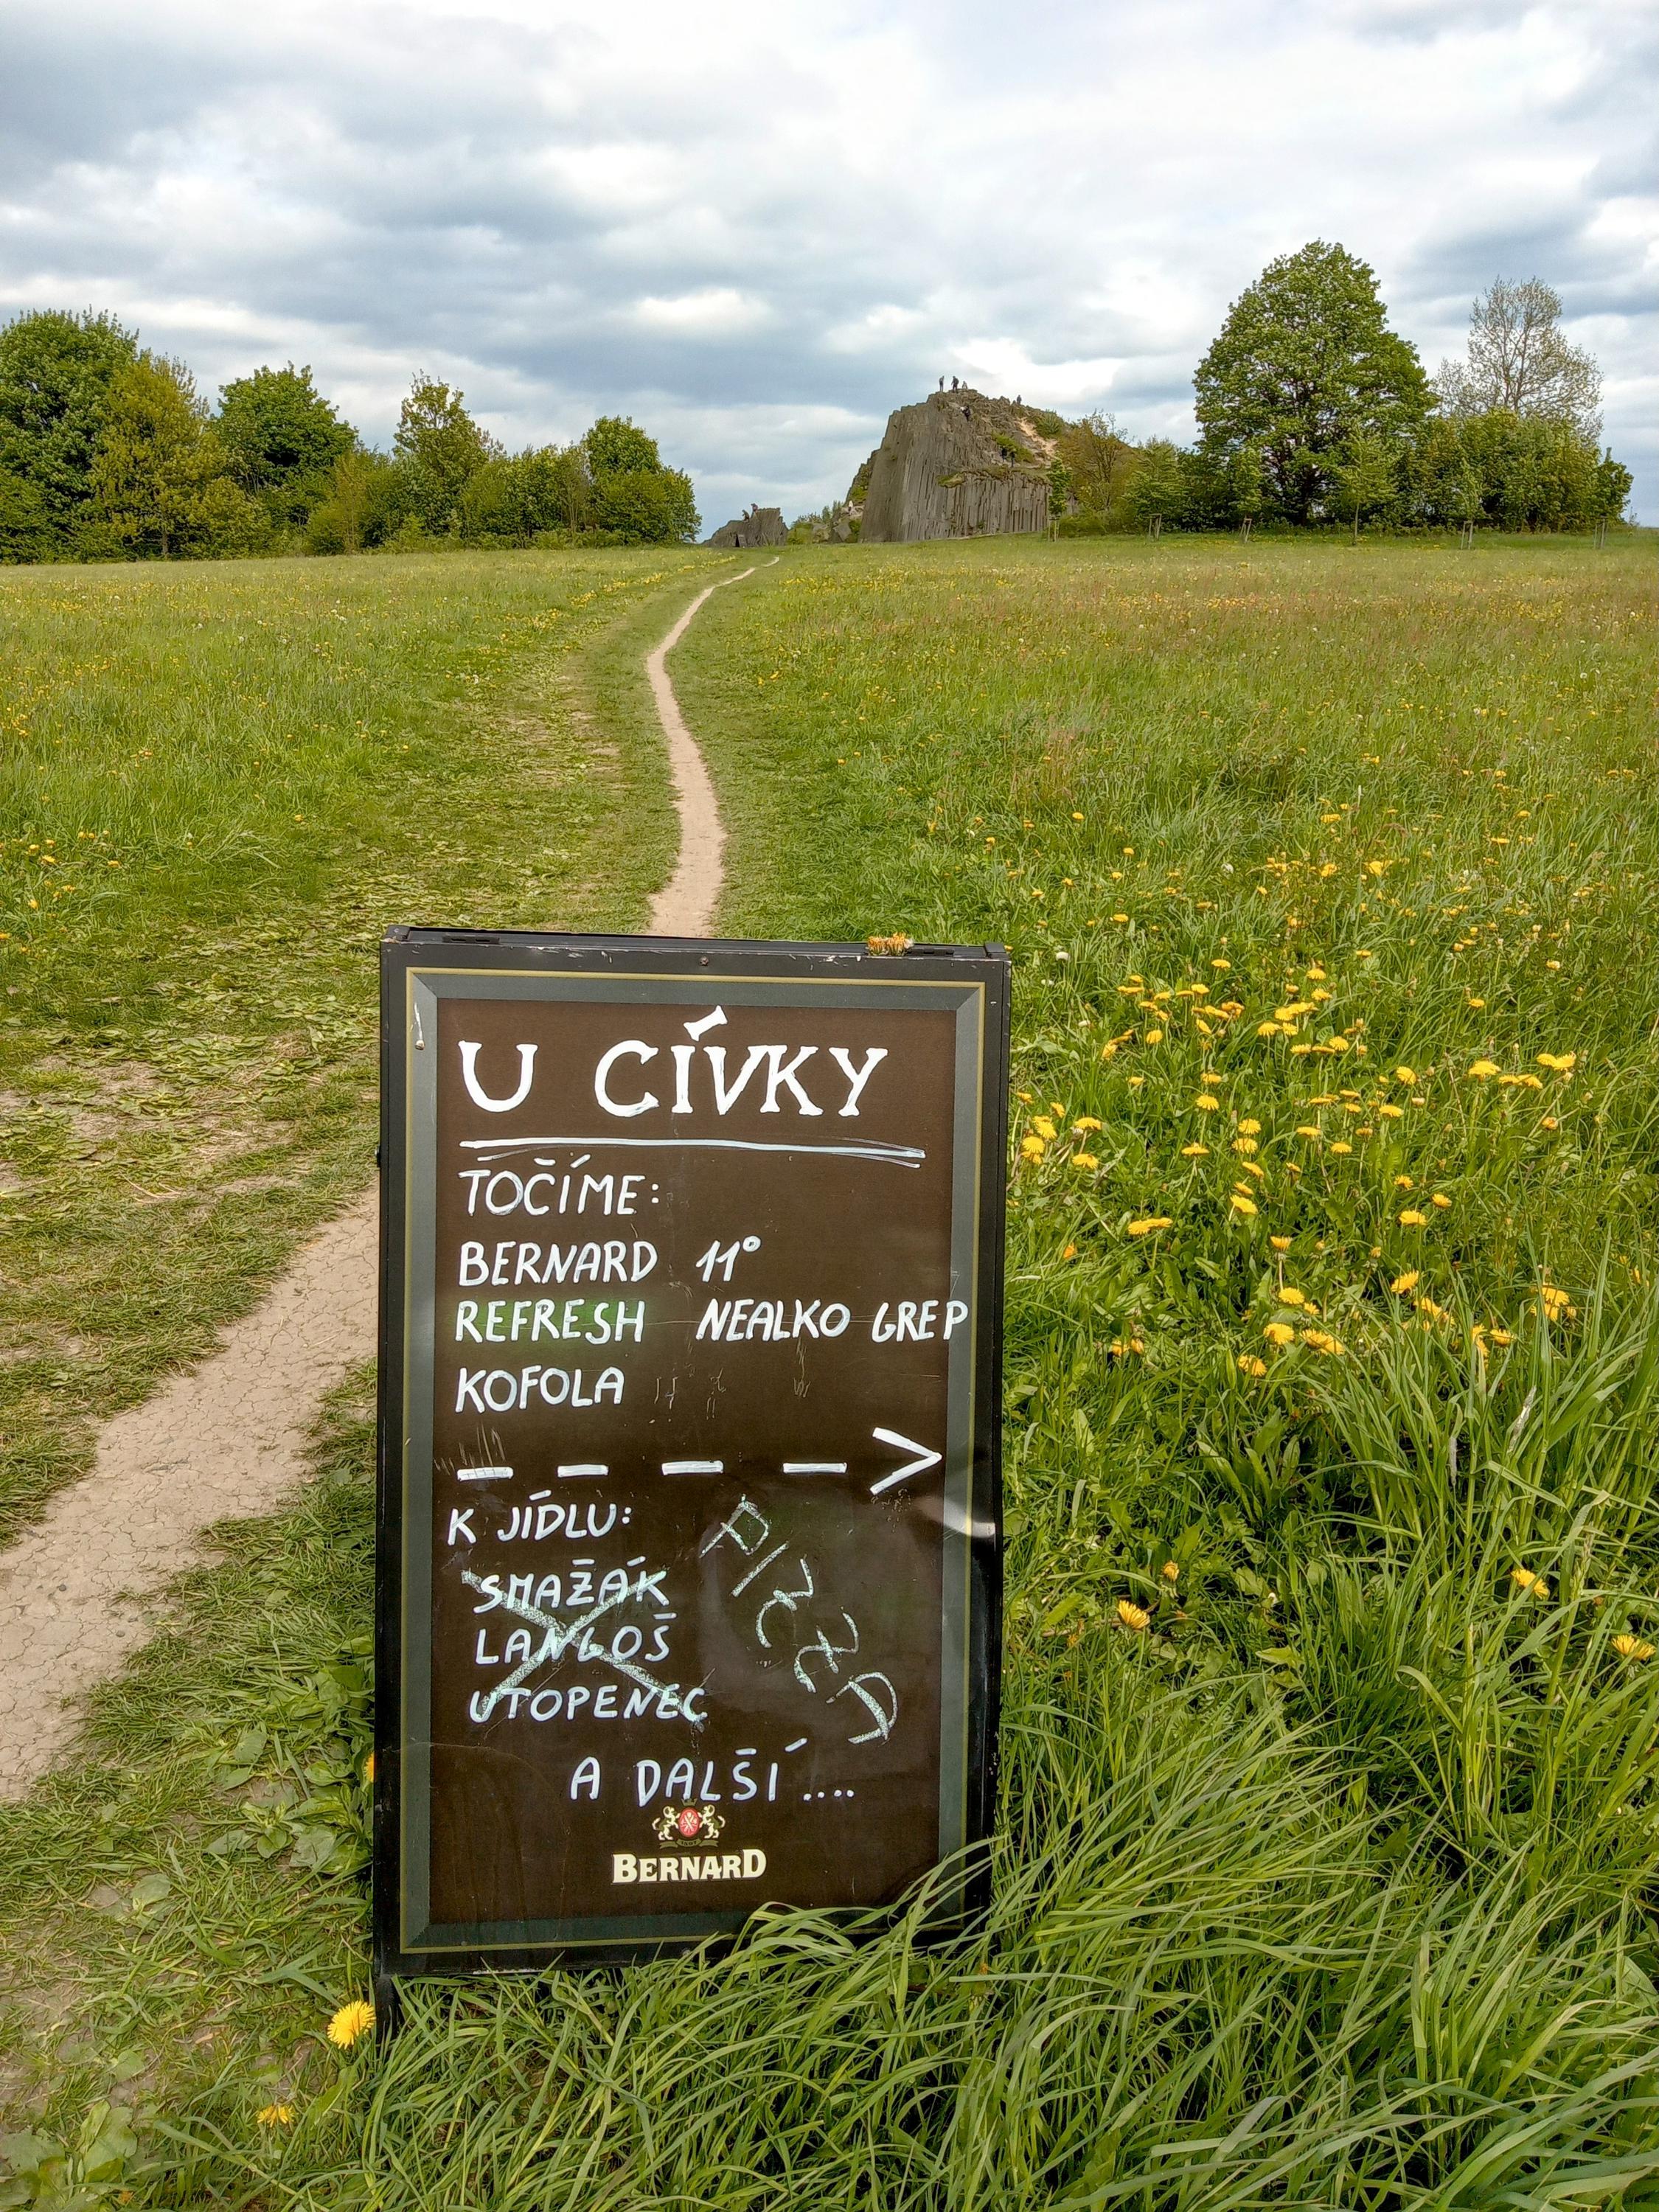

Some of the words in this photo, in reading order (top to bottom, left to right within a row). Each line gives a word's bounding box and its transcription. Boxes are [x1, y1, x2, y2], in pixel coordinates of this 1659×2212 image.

[458, 1040, 538, 1113] U
[594, 1005, 888, 1117] CÍVKY
[458, 1153, 659, 1216] TOČÍME:
[459, 1240, 658, 1287] BERNARD
[695, 1235, 761, 1283] 11°
[455, 1298, 645, 1345] REFRESH
[695, 1298, 851, 1342] NEALKO
[872, 1300, 969, 1343] GREP
[455, 1364, 625, 1413] KOFOLA
[448, 1508, 476, 1545] K
[497, 1489, 632, 1542] JÍDLU:
[473, 1555, 671, 1614] SMAŽÁK
[469, 1681, 709, 1724] UTOPENEC
[570, 1756, 601, 1801] A
[611, 1848, 768, 1884] BERNARD
